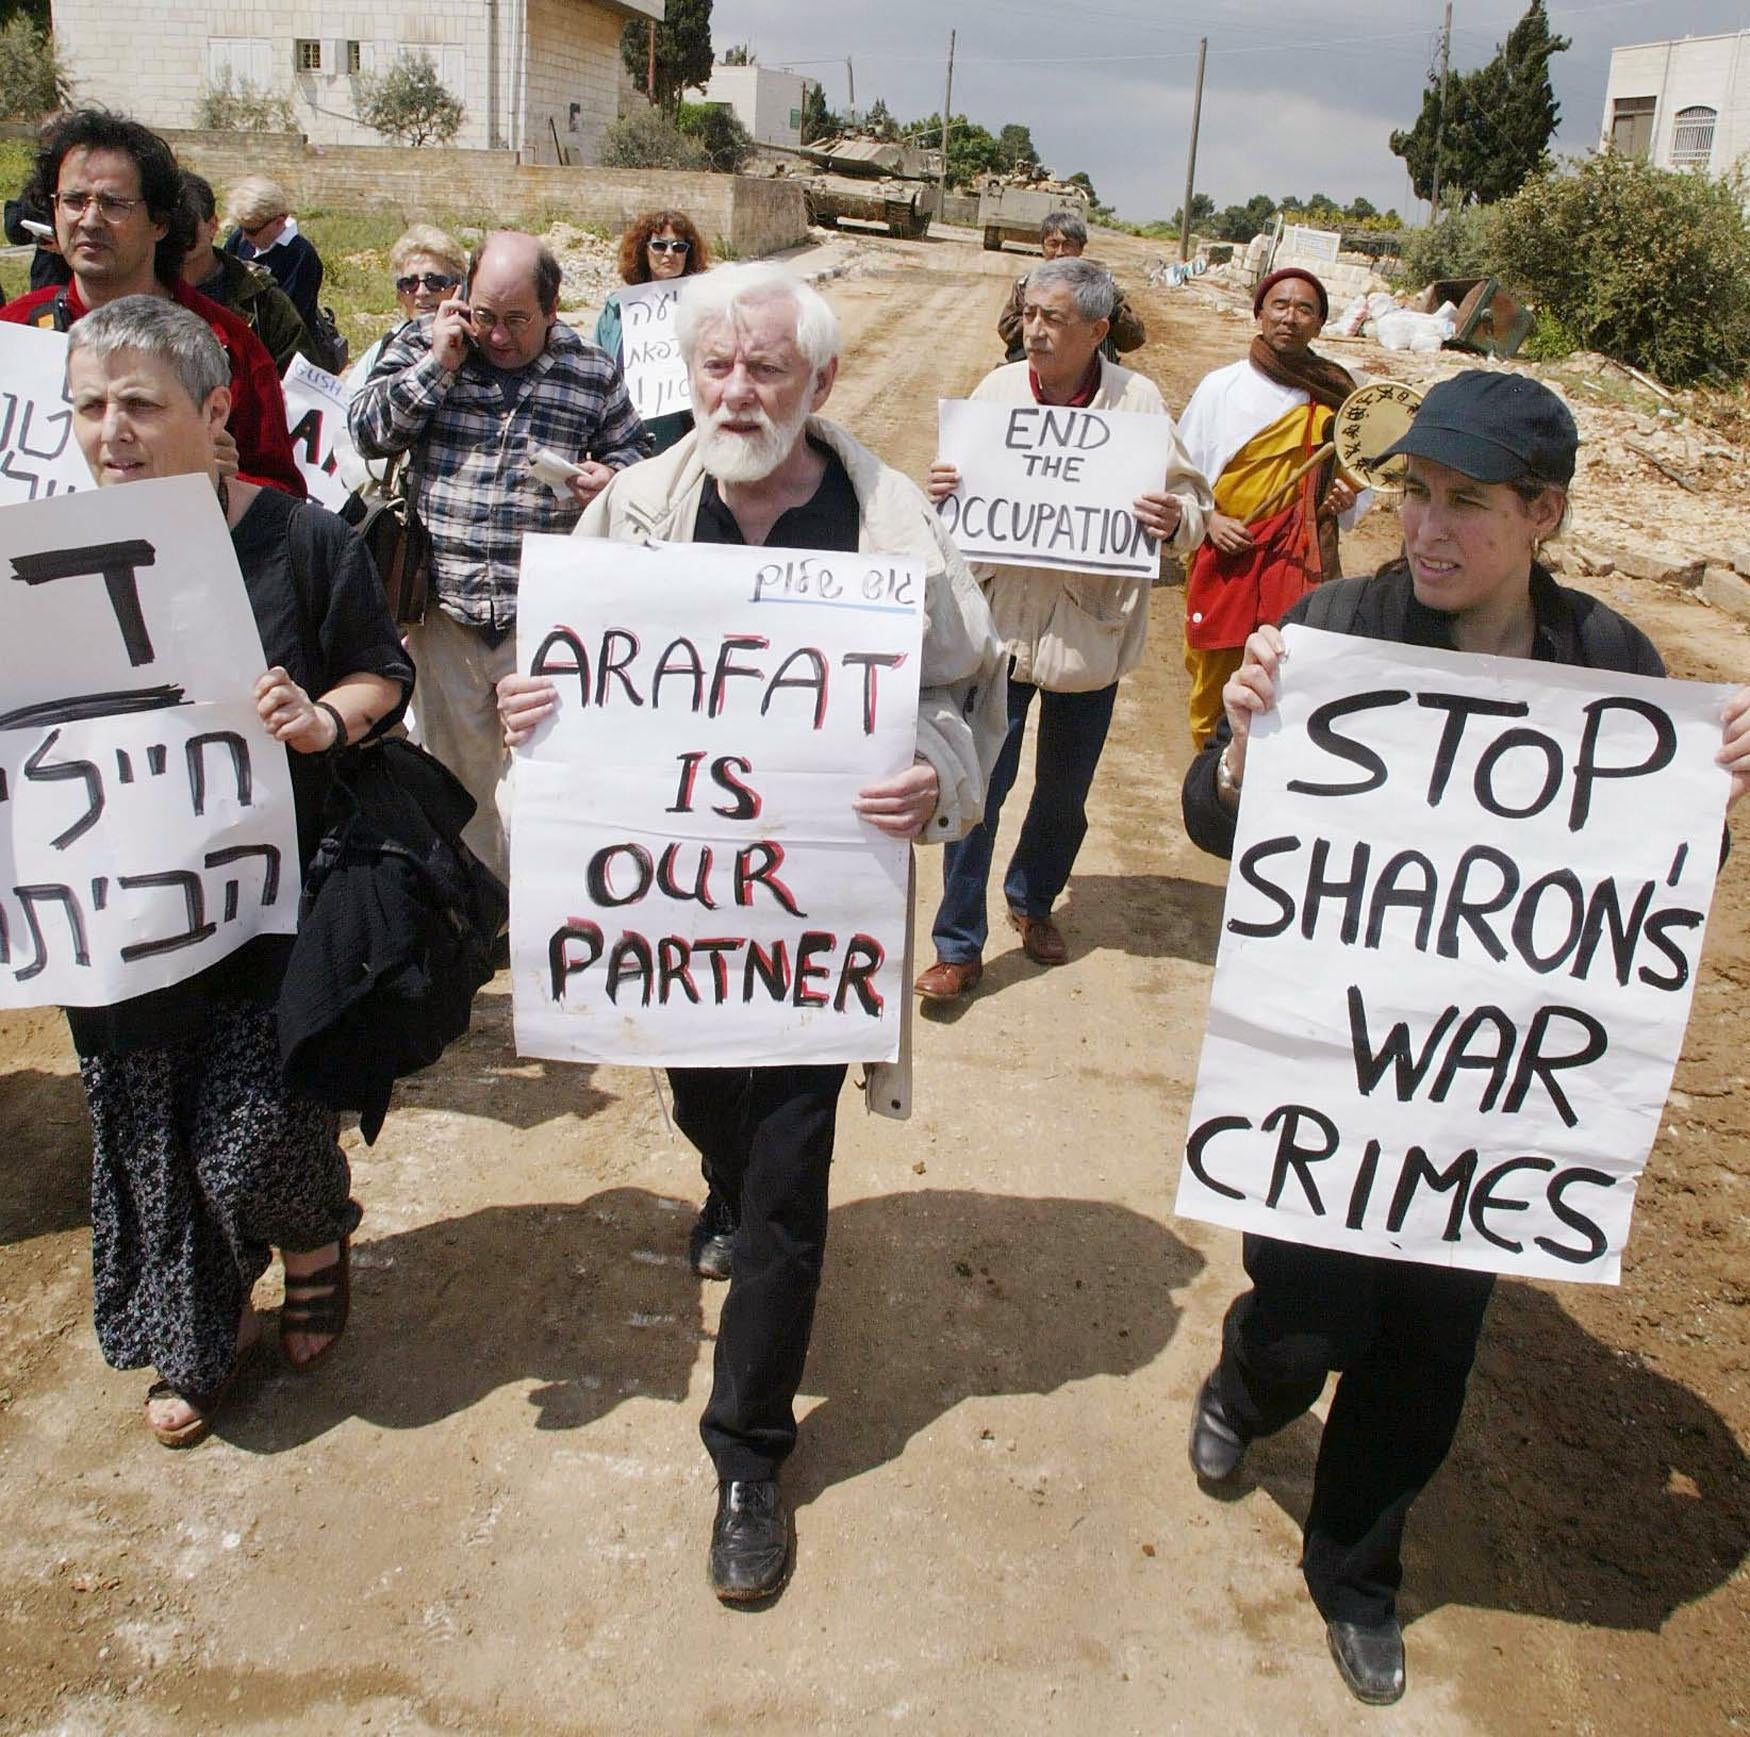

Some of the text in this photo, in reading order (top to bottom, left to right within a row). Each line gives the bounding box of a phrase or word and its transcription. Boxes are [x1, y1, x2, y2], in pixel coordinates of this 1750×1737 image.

[1005, 407, 1111, 450] END
[1022, 454, 1085, 482] THE
[937, 493, 1158, 557] OCCUPATION
[530, 624, 909, 736] ARAFAT
[664, 751, 763, 821] IS
[1286, 689, 1678, 832] STOP
[0, 843, 281, 982] הבית
[585, 840, 808, 919] OUR
[1226, 835, 1705, 992] SHARON'S
[548, 916, 886, 1019] PARTNER
[1347, 985, 1608, 1129] WAR
[1186, 1104, 1617, 1265] CRIMES
